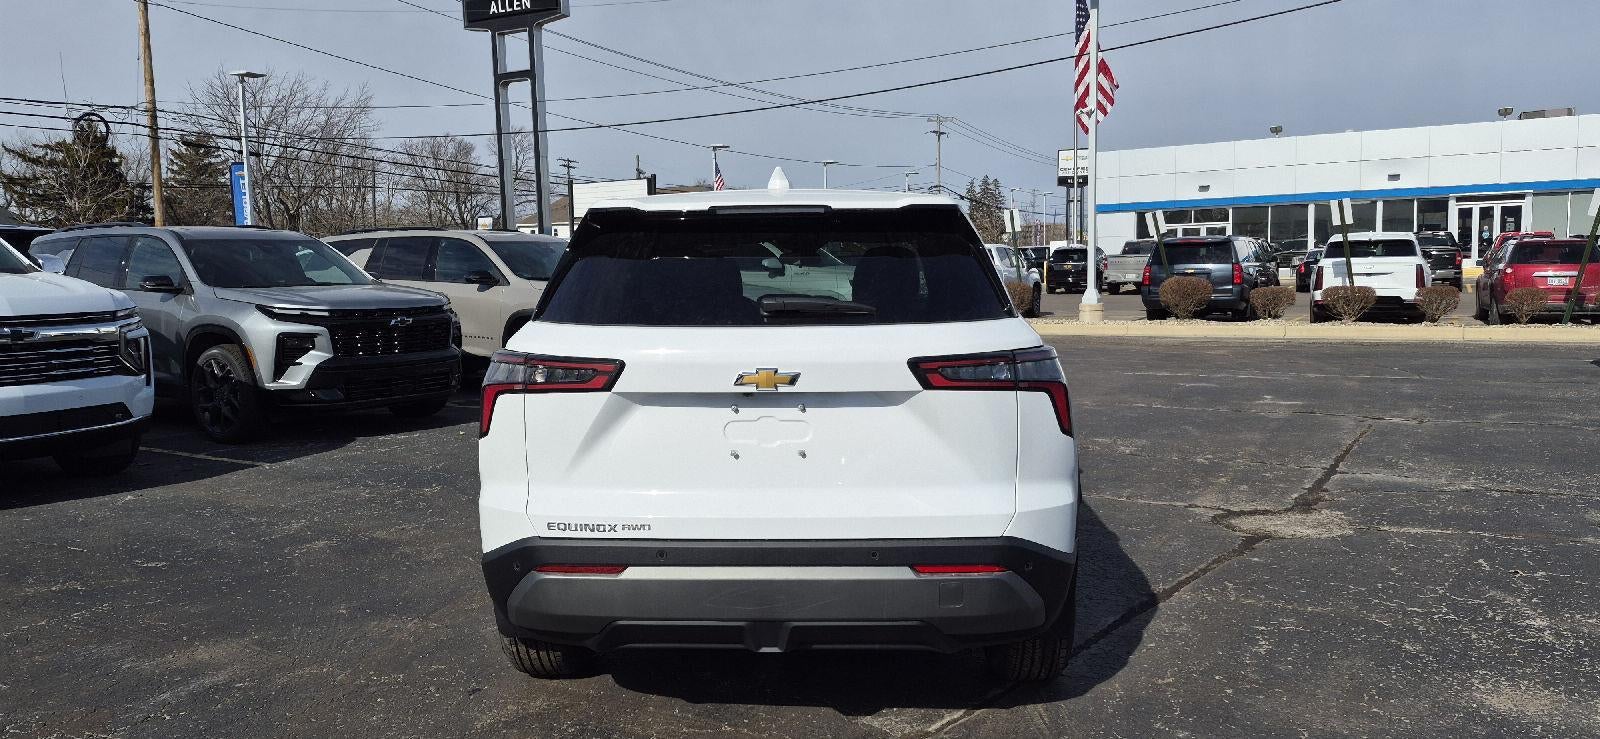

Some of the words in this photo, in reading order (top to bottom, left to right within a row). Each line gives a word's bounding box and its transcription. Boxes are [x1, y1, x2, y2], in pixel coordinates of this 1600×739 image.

[489, 0, 531, 14] ALLEN
[547, 522, 618, 532] EQUINOX
[621, 523, 651, 531] AWD
